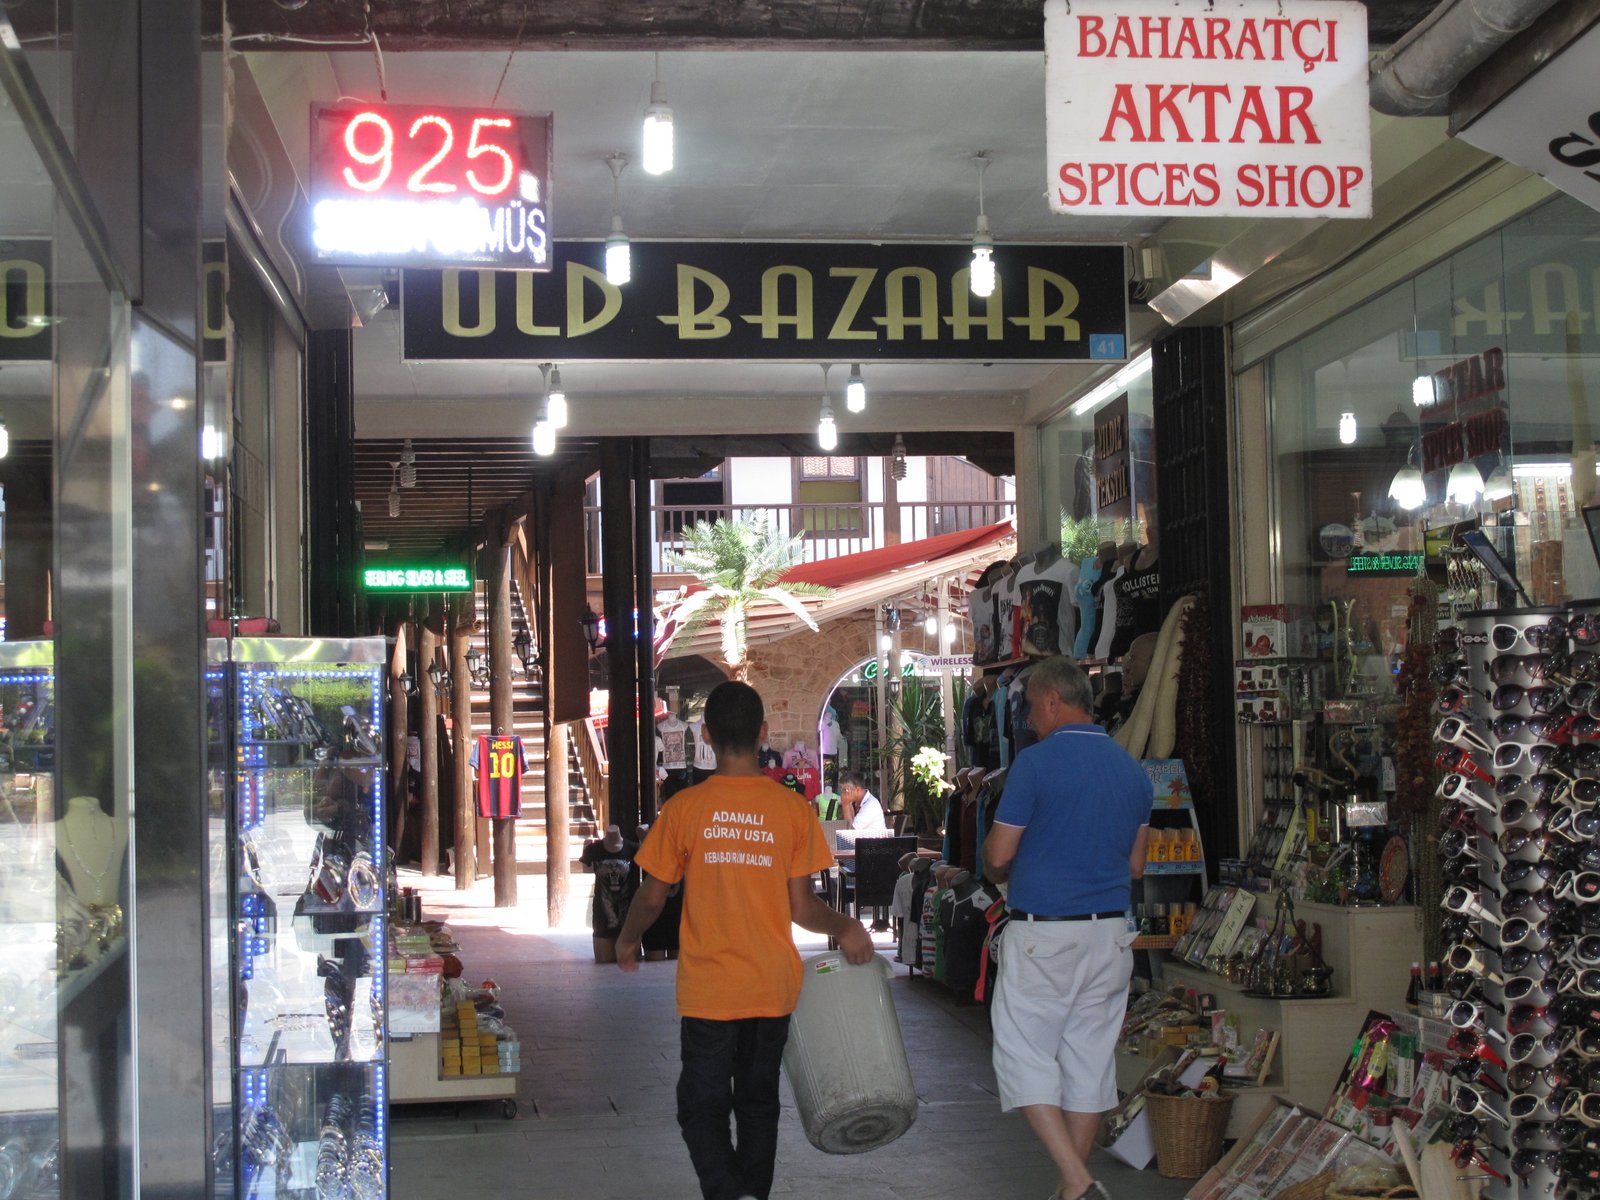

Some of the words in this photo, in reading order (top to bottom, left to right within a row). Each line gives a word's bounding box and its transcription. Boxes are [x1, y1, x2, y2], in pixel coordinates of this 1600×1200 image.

[1077, 15, 1338, 73] BAHARATÇI
[1099, 83, 1321, 144] AKTAR
[343, 112, 514, 195] 925
[1058, 162, 1221, 207] SPICES
[1236, 164, 1364, 208] SHOP
[442, 261, 623, 338] OLD
[656, 263, 1081, 341] BAZAAR
[1096, 340, 1116, 354] 41
[489, 752, 515, 778] 10
[703, 825, 742, 840] GÜRAY
[744, 829, 774, 844] USTA
[712, 811, 764, 826] ADANALI
[746, 853, 773, 868] SALONU
